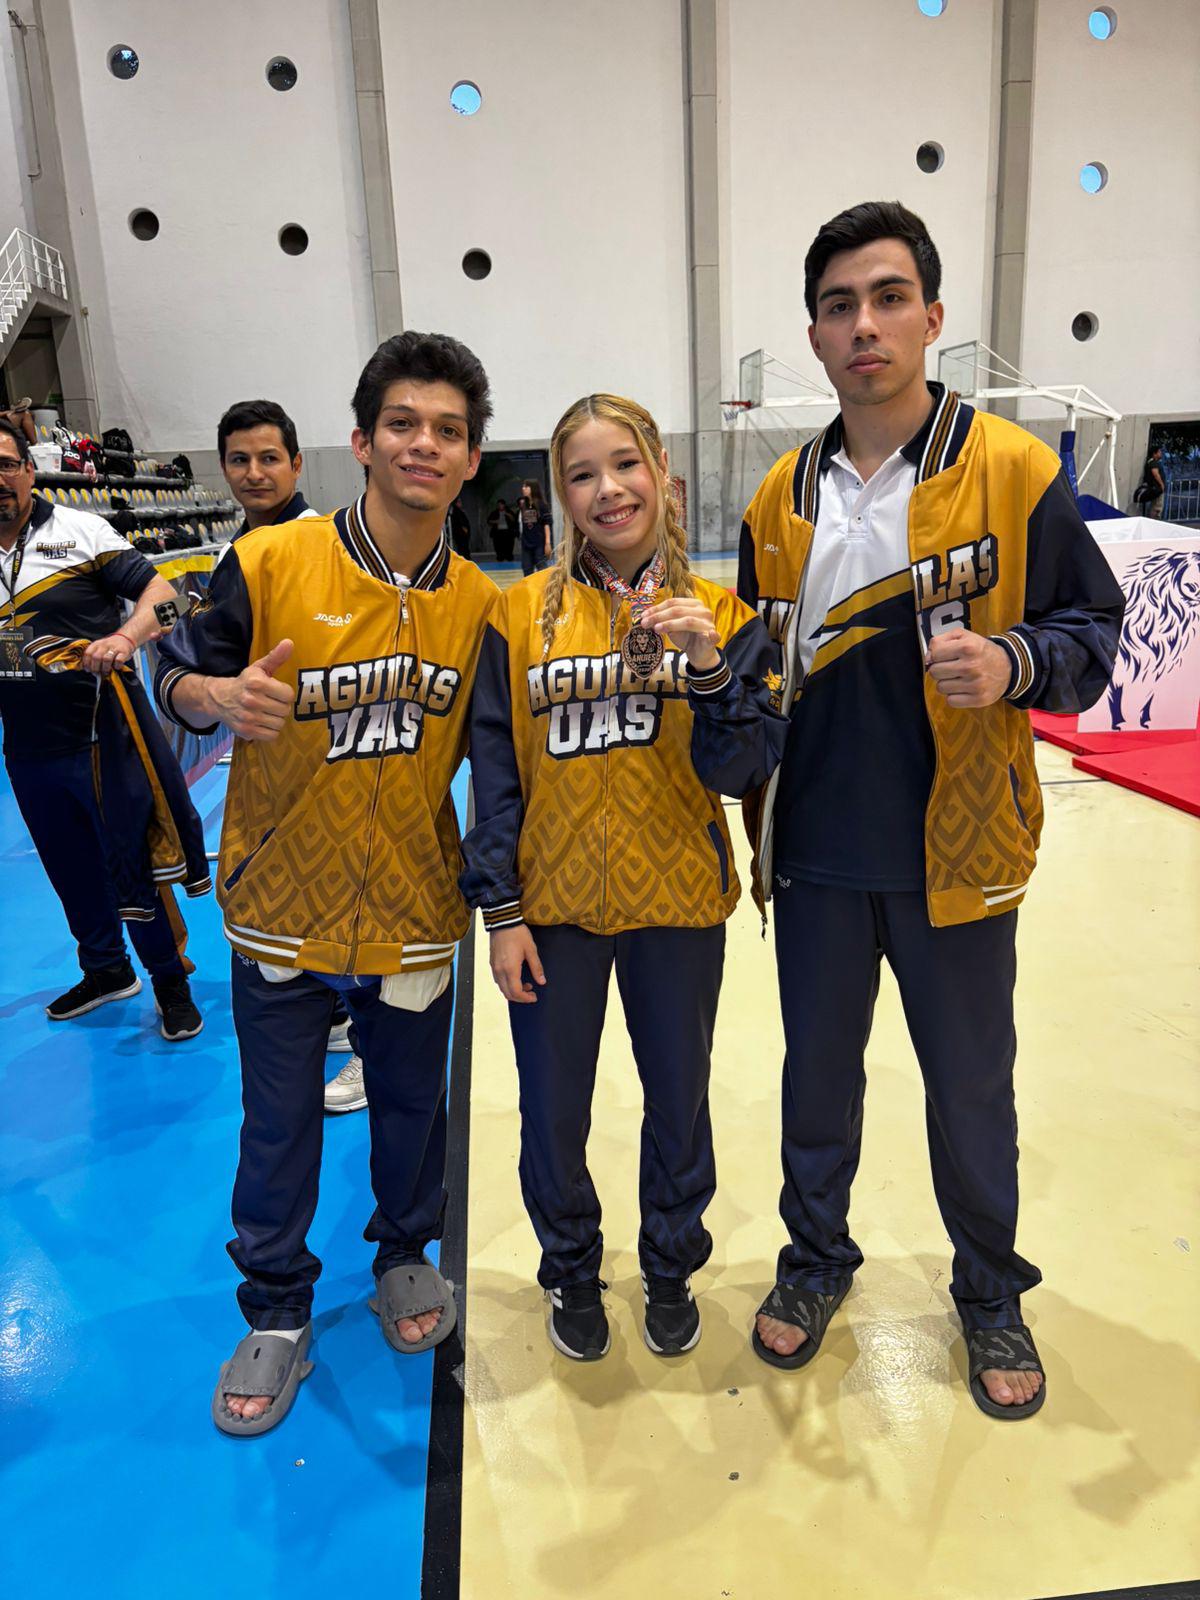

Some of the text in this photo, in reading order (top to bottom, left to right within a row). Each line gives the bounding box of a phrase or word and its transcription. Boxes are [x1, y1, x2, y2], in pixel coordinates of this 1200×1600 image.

[43, 549, 67, 560] UAS
[326, 700, 426, 764] UAS
[548, 693, 660, 759] UAS
